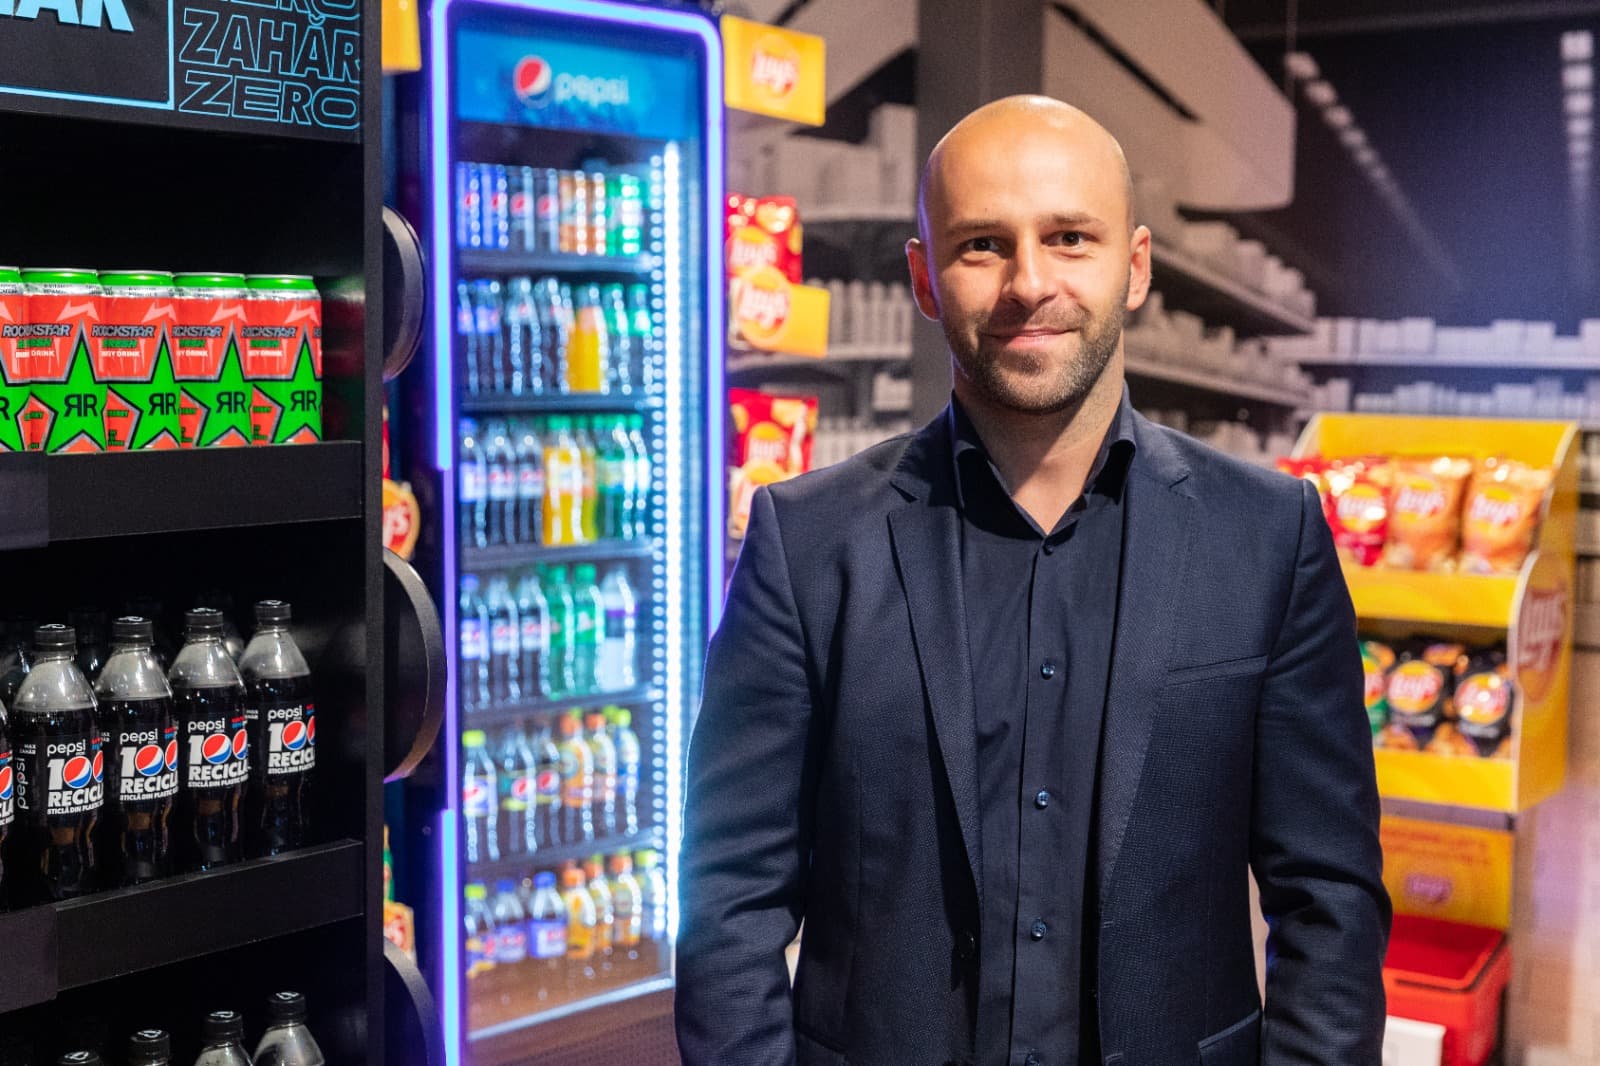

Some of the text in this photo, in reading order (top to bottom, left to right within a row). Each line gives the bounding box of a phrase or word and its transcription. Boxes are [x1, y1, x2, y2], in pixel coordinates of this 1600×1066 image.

[554, 72, 629, 107] pepsi
[178, 69, 360, 130] ZERO
[31, 349, 55, 357] DRINK
[267, 704, 303, 722] pepsi
[187, 718, 225, 733] pepsi
[119, 728, 158, 745] pepsi
[47, 738, 86, 757] pepsi
[16, 757, 29, 810] pepsi
